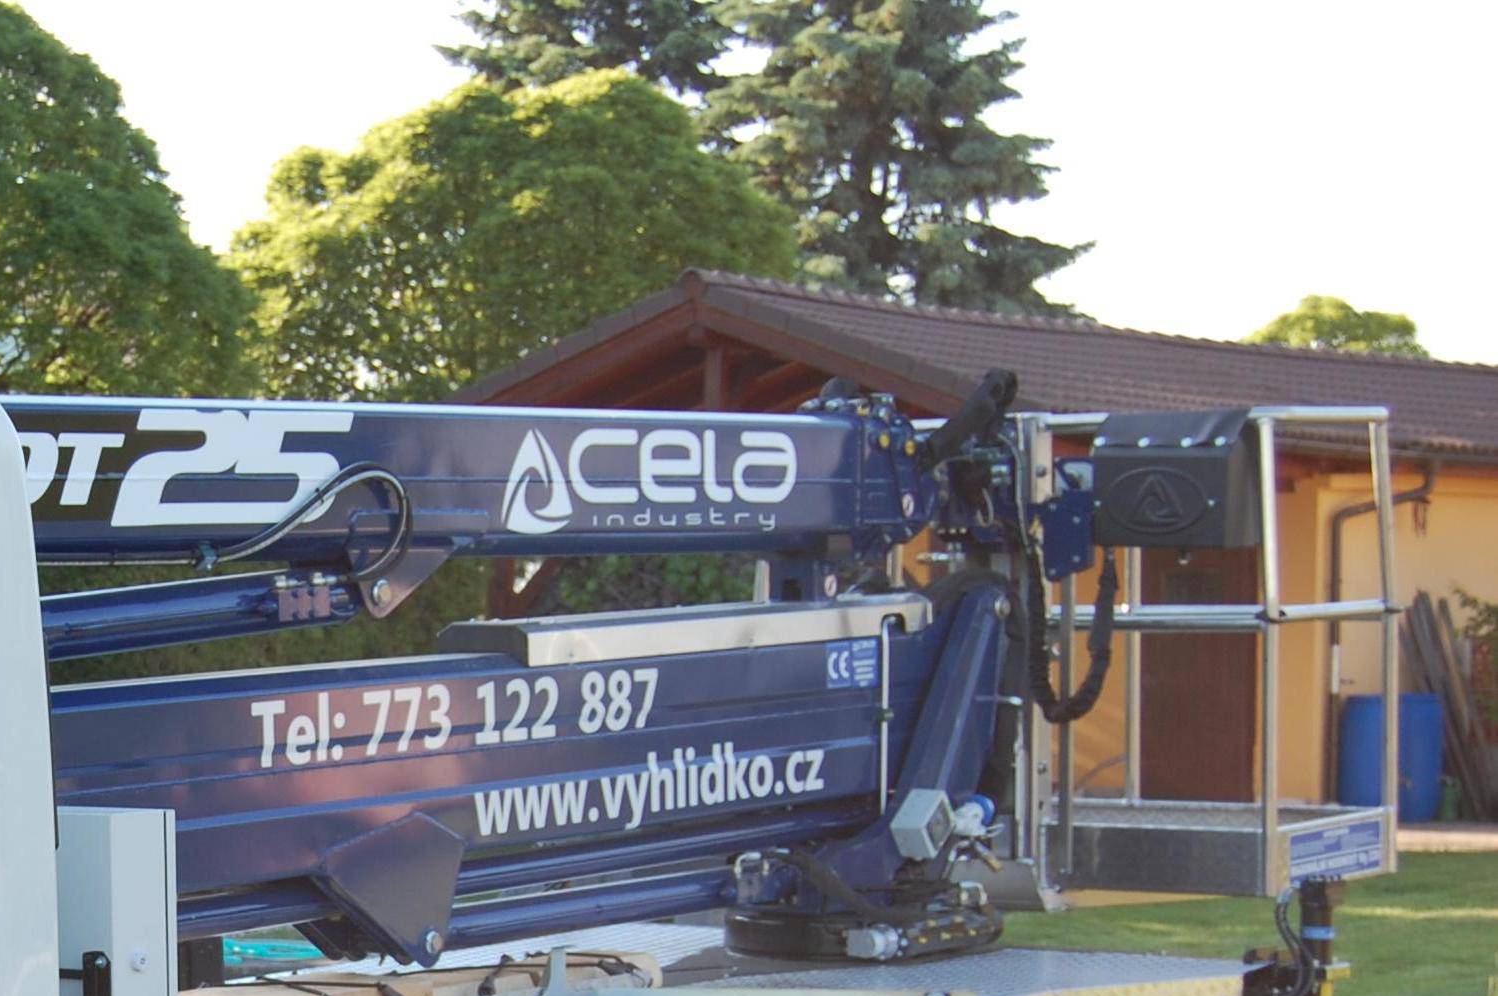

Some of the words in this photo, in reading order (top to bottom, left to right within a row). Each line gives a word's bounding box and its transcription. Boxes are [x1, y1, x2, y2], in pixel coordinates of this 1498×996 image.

[110, 408, 354, 528] 25
[592, 507, 776, 532] industry
[250, 691, 346, 768] Tel:
[362, 684, 453, 757] 773
[475, 676, 560, 746] 122
[578, 668, 659, 735] 887
[473, 741, 825, 837] www.vyhlidko.cz
